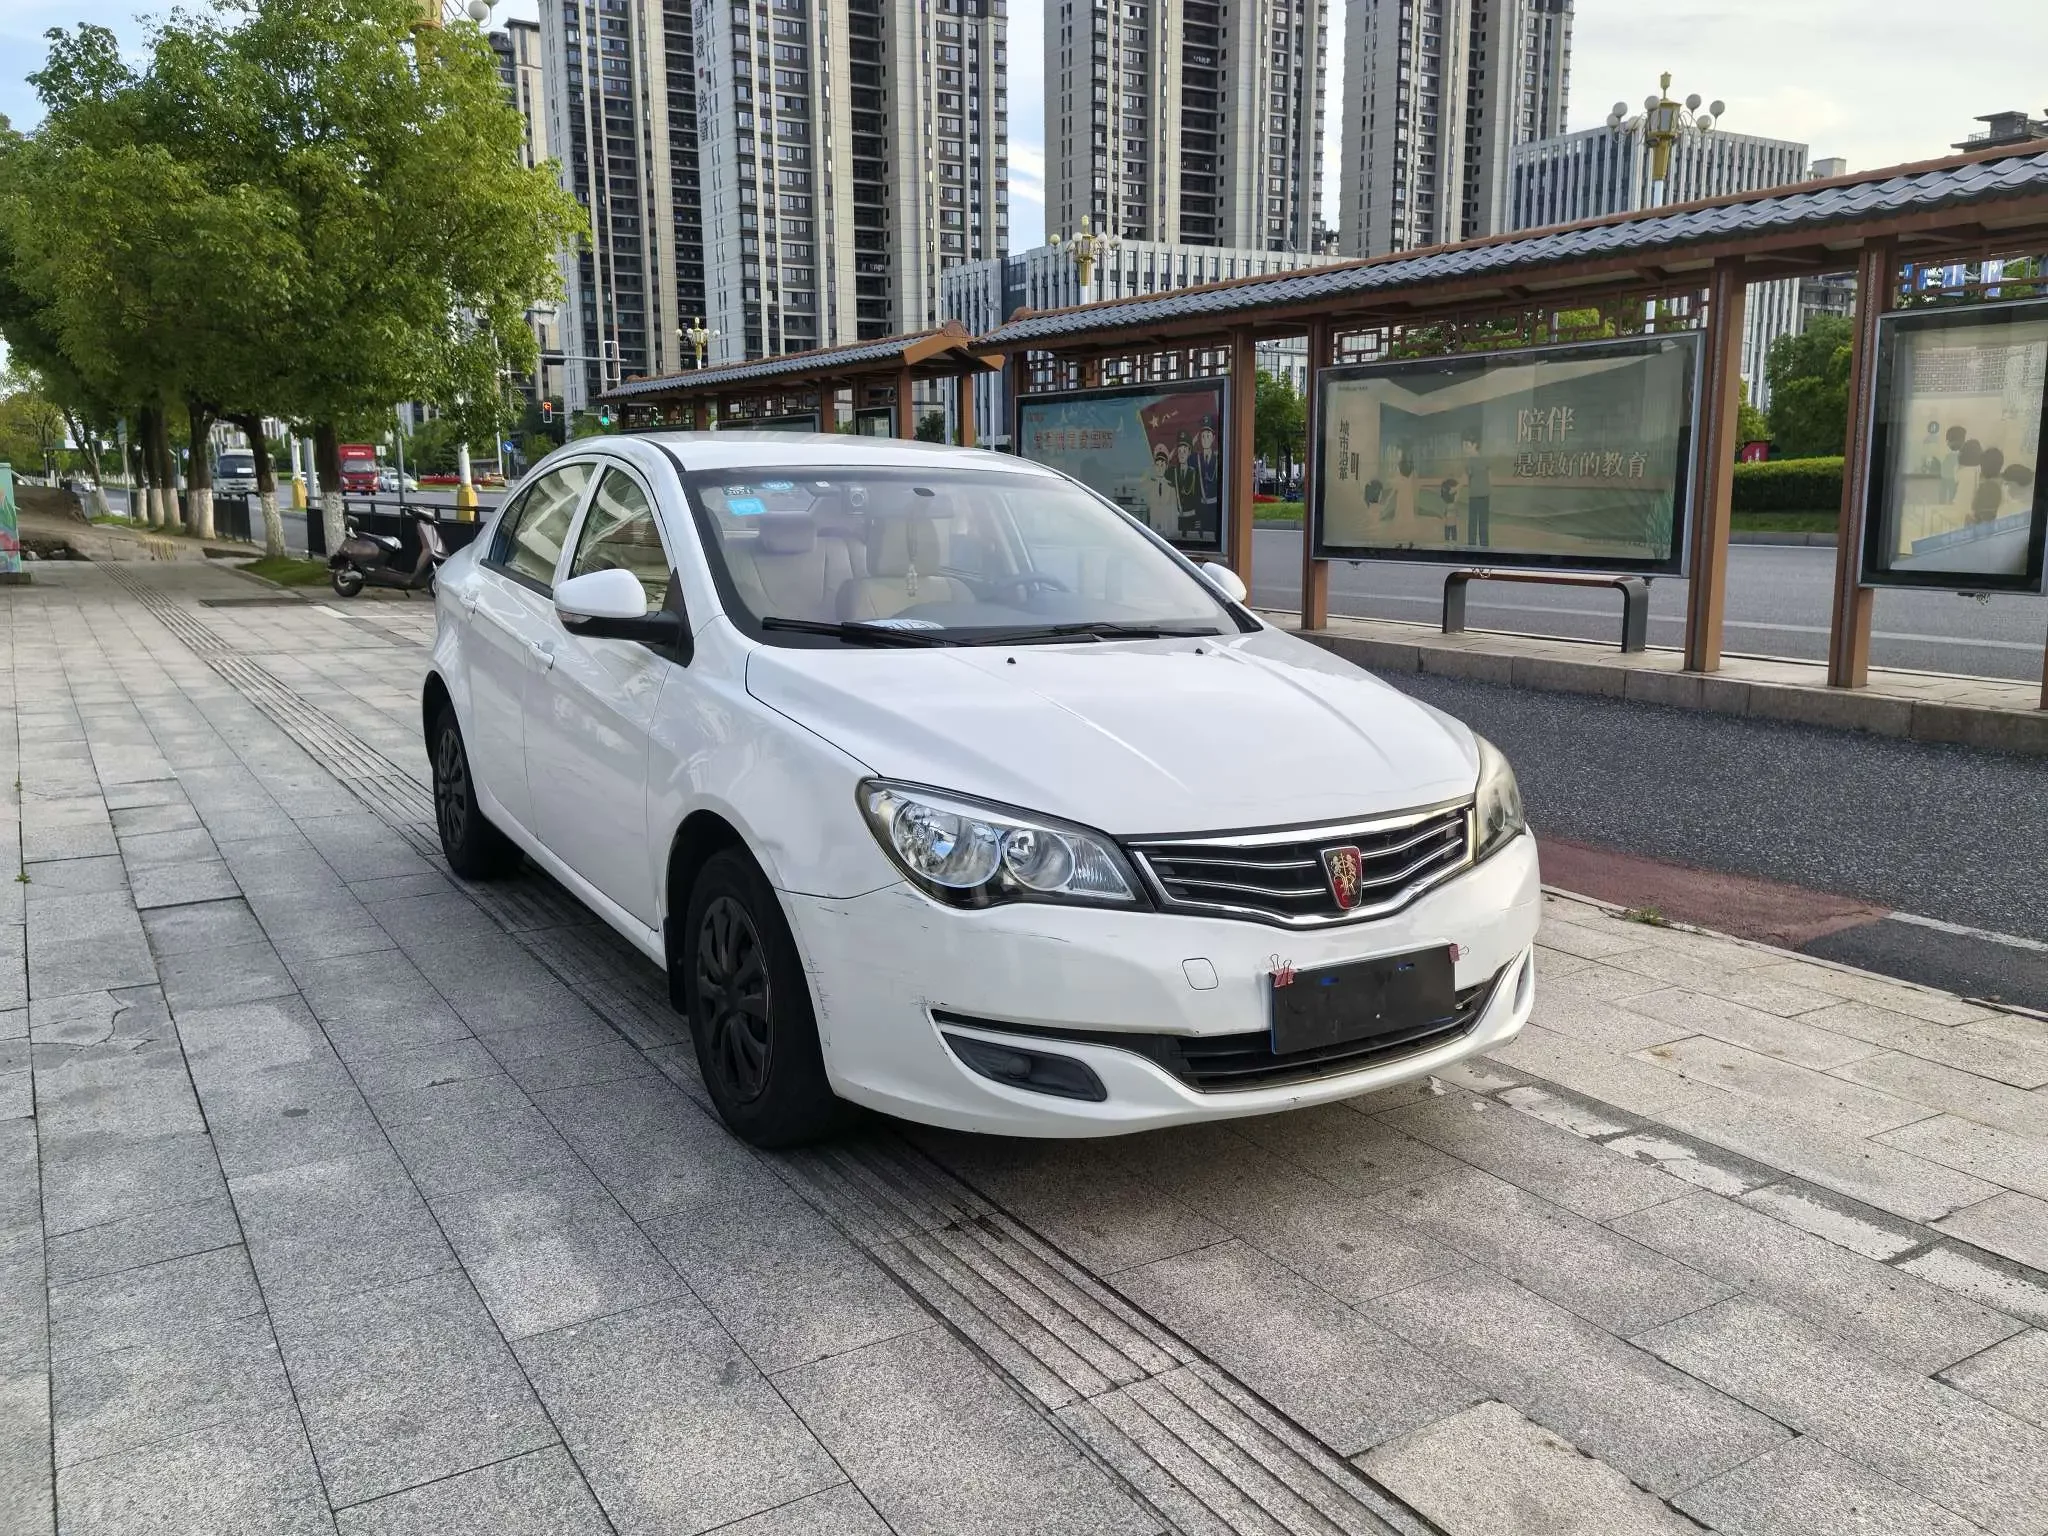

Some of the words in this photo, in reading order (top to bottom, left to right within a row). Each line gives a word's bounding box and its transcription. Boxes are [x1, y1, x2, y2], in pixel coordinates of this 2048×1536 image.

[1516, 405, 1576, 443] 陪伴
[1514, 450, 1648, 479] 是最好的教育
